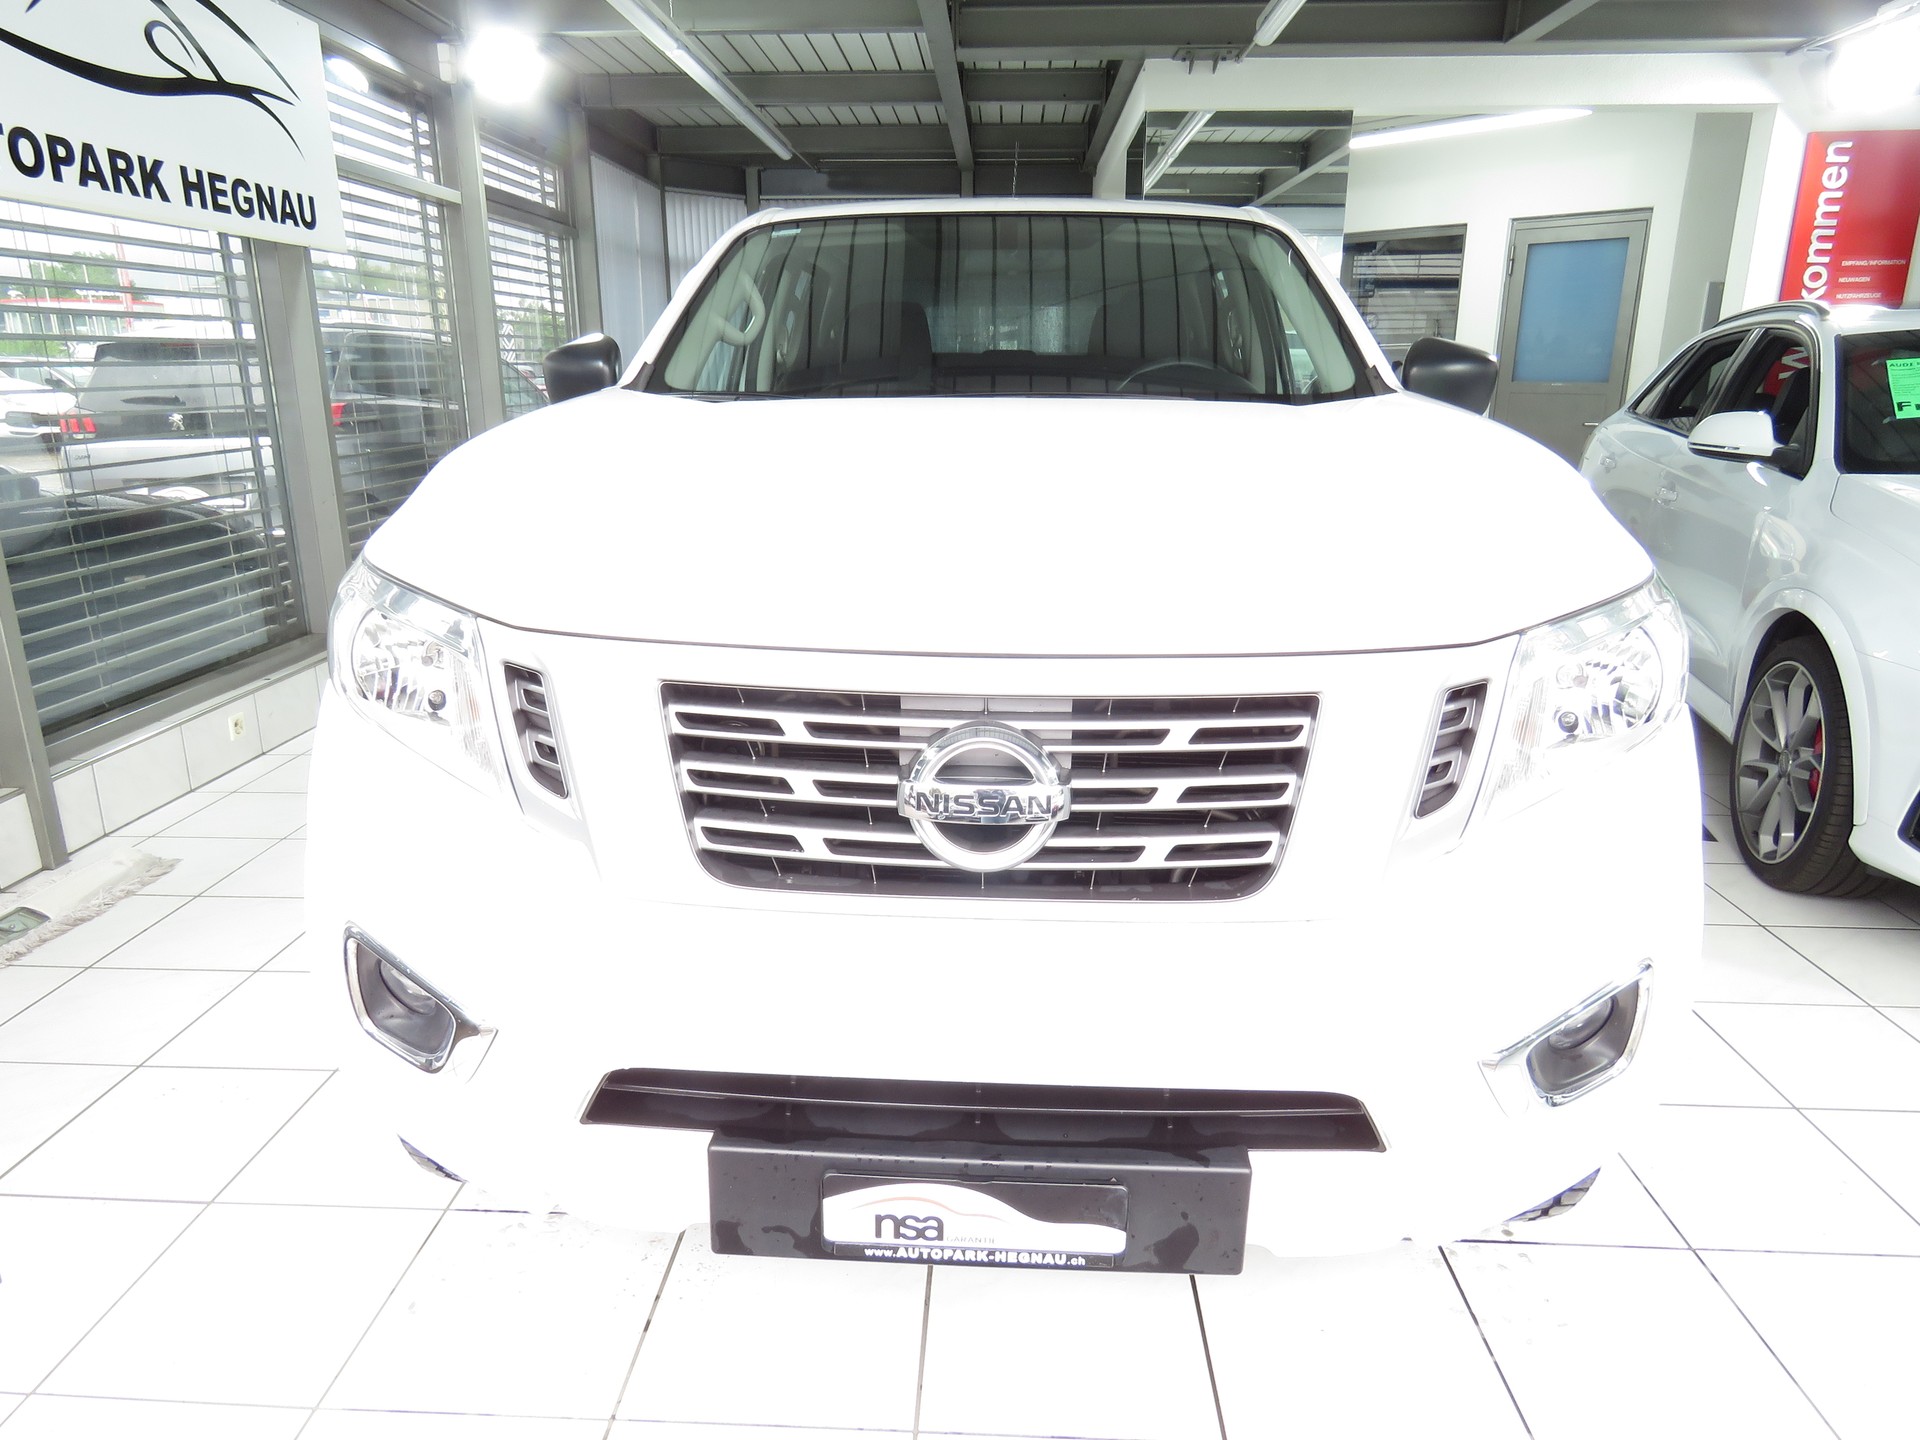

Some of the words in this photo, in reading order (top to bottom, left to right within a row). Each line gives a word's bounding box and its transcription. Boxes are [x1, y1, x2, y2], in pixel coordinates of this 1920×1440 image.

[0, 122, 171, 203] OPARK
[179, 165, 317, 231] HEGNAU
[1841, 259, 1906, 267] EMPFANG/INFORMATION
[915, 791, 1052, 818] NISSAN
[875, 1214, 944, 1241] nsa
[864, 1246, 1086, 1266] www.AUTOPARK-HEGNAU.ch
